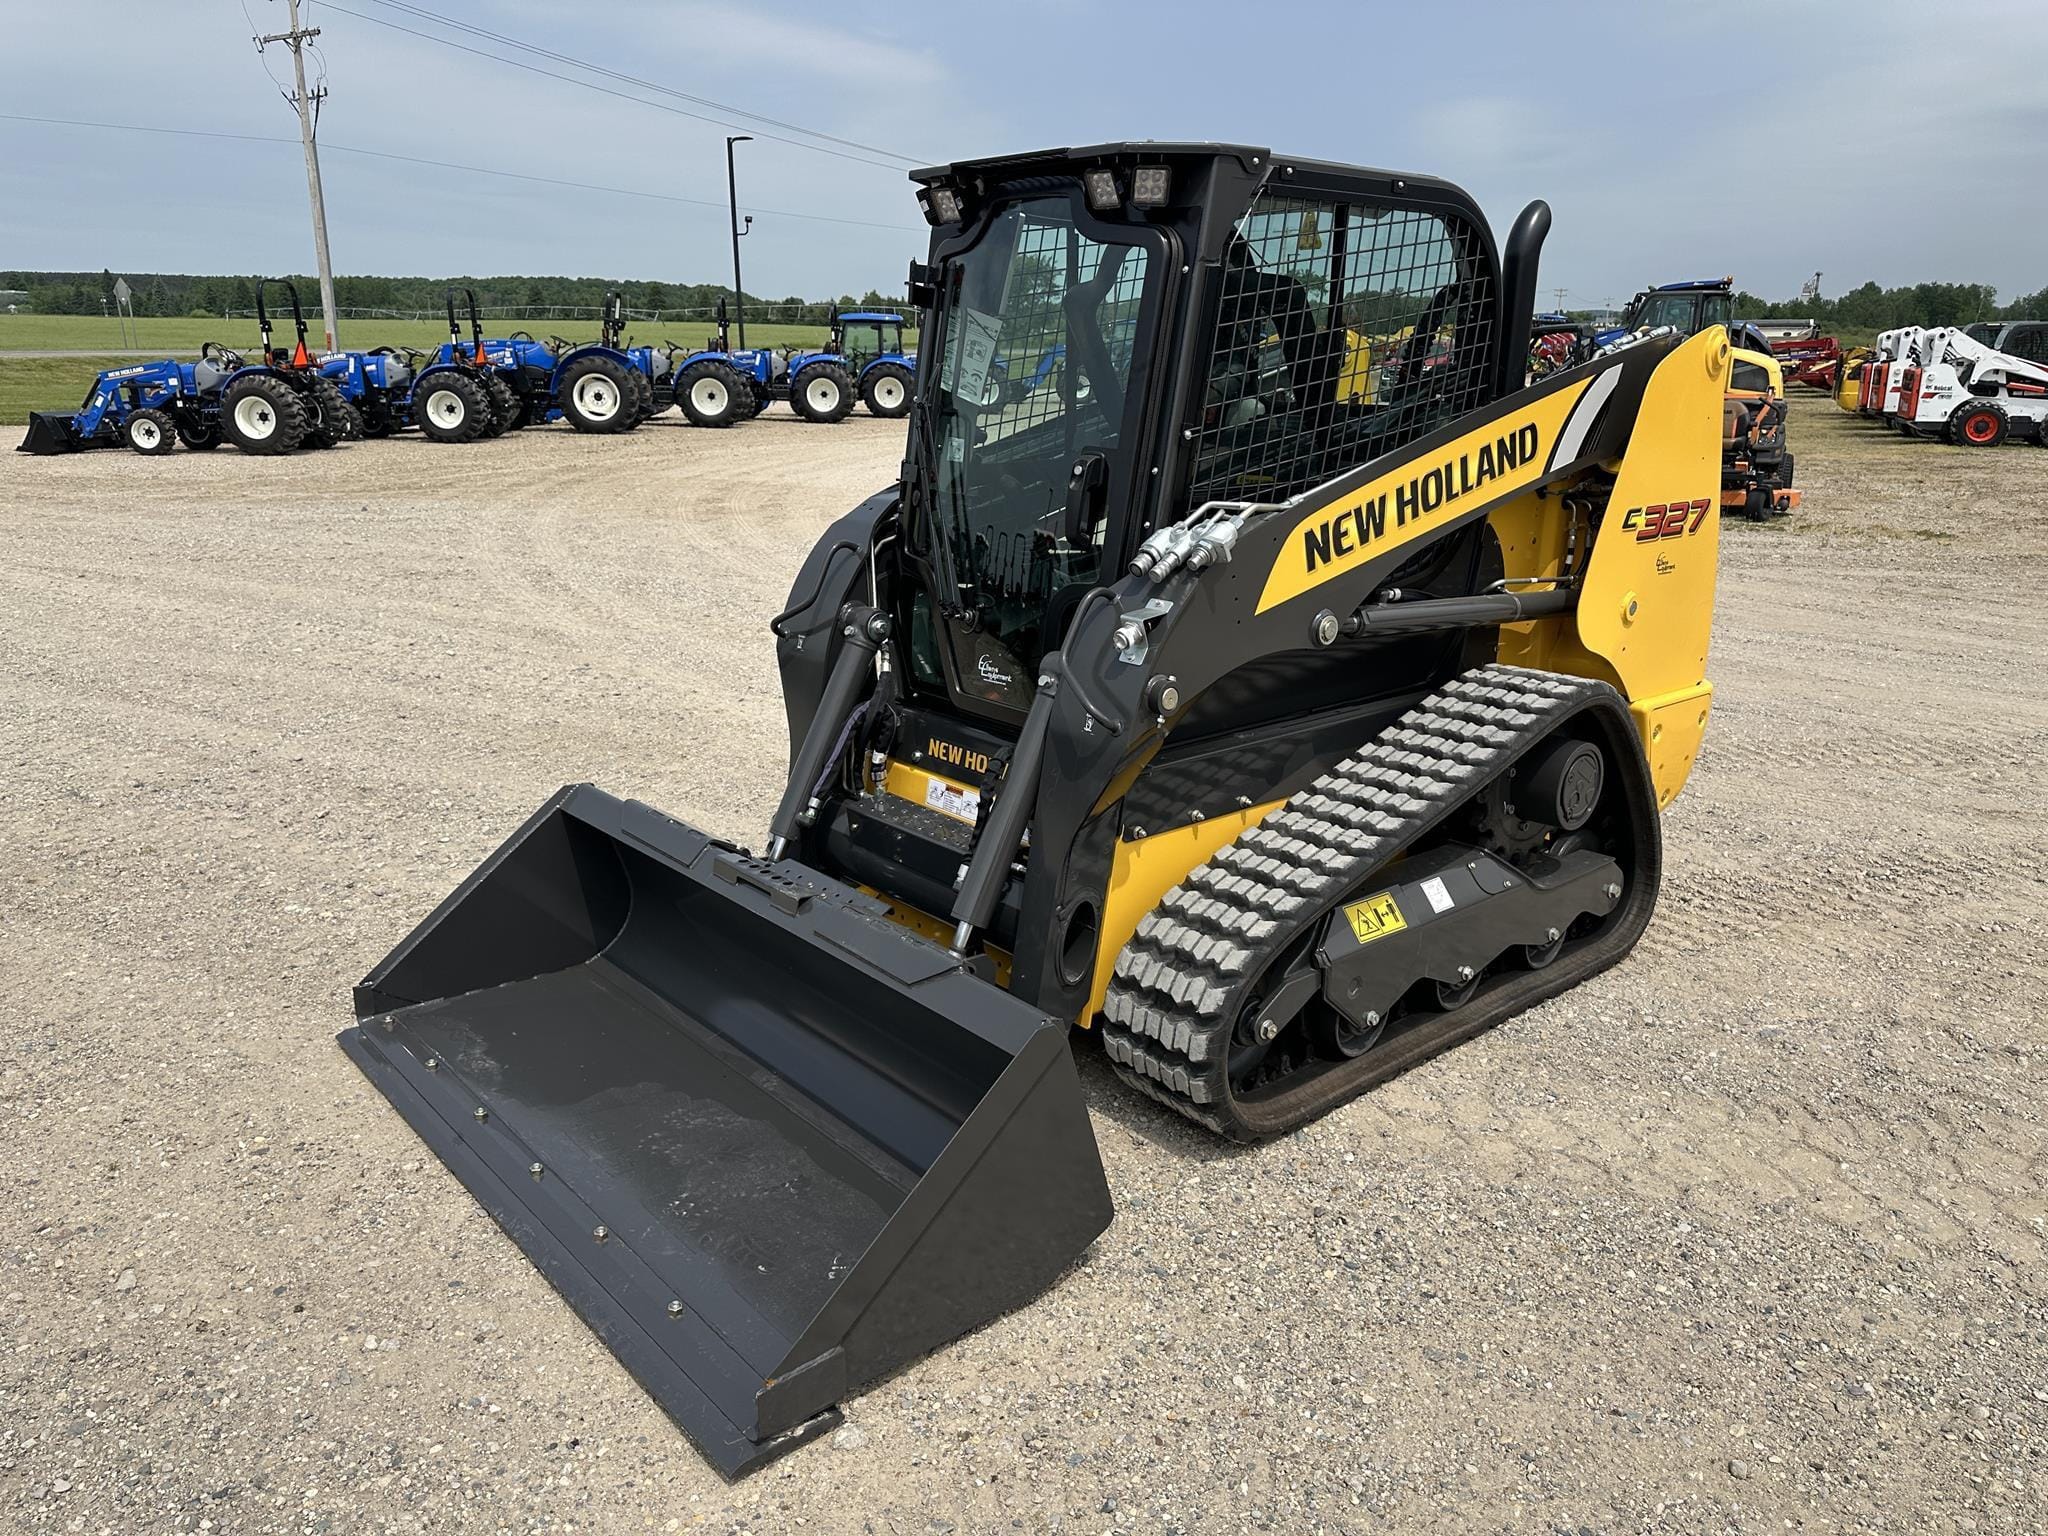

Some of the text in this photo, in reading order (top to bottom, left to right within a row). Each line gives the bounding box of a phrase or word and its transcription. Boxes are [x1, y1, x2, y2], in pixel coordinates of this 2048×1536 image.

[120, 366, 144, 376] HOLLAND
[1304, 422, 1539, 573] NEW HOLLAND
[1622, 499, 1711, 542] C327
[928, 738, 963, 765] NEW
